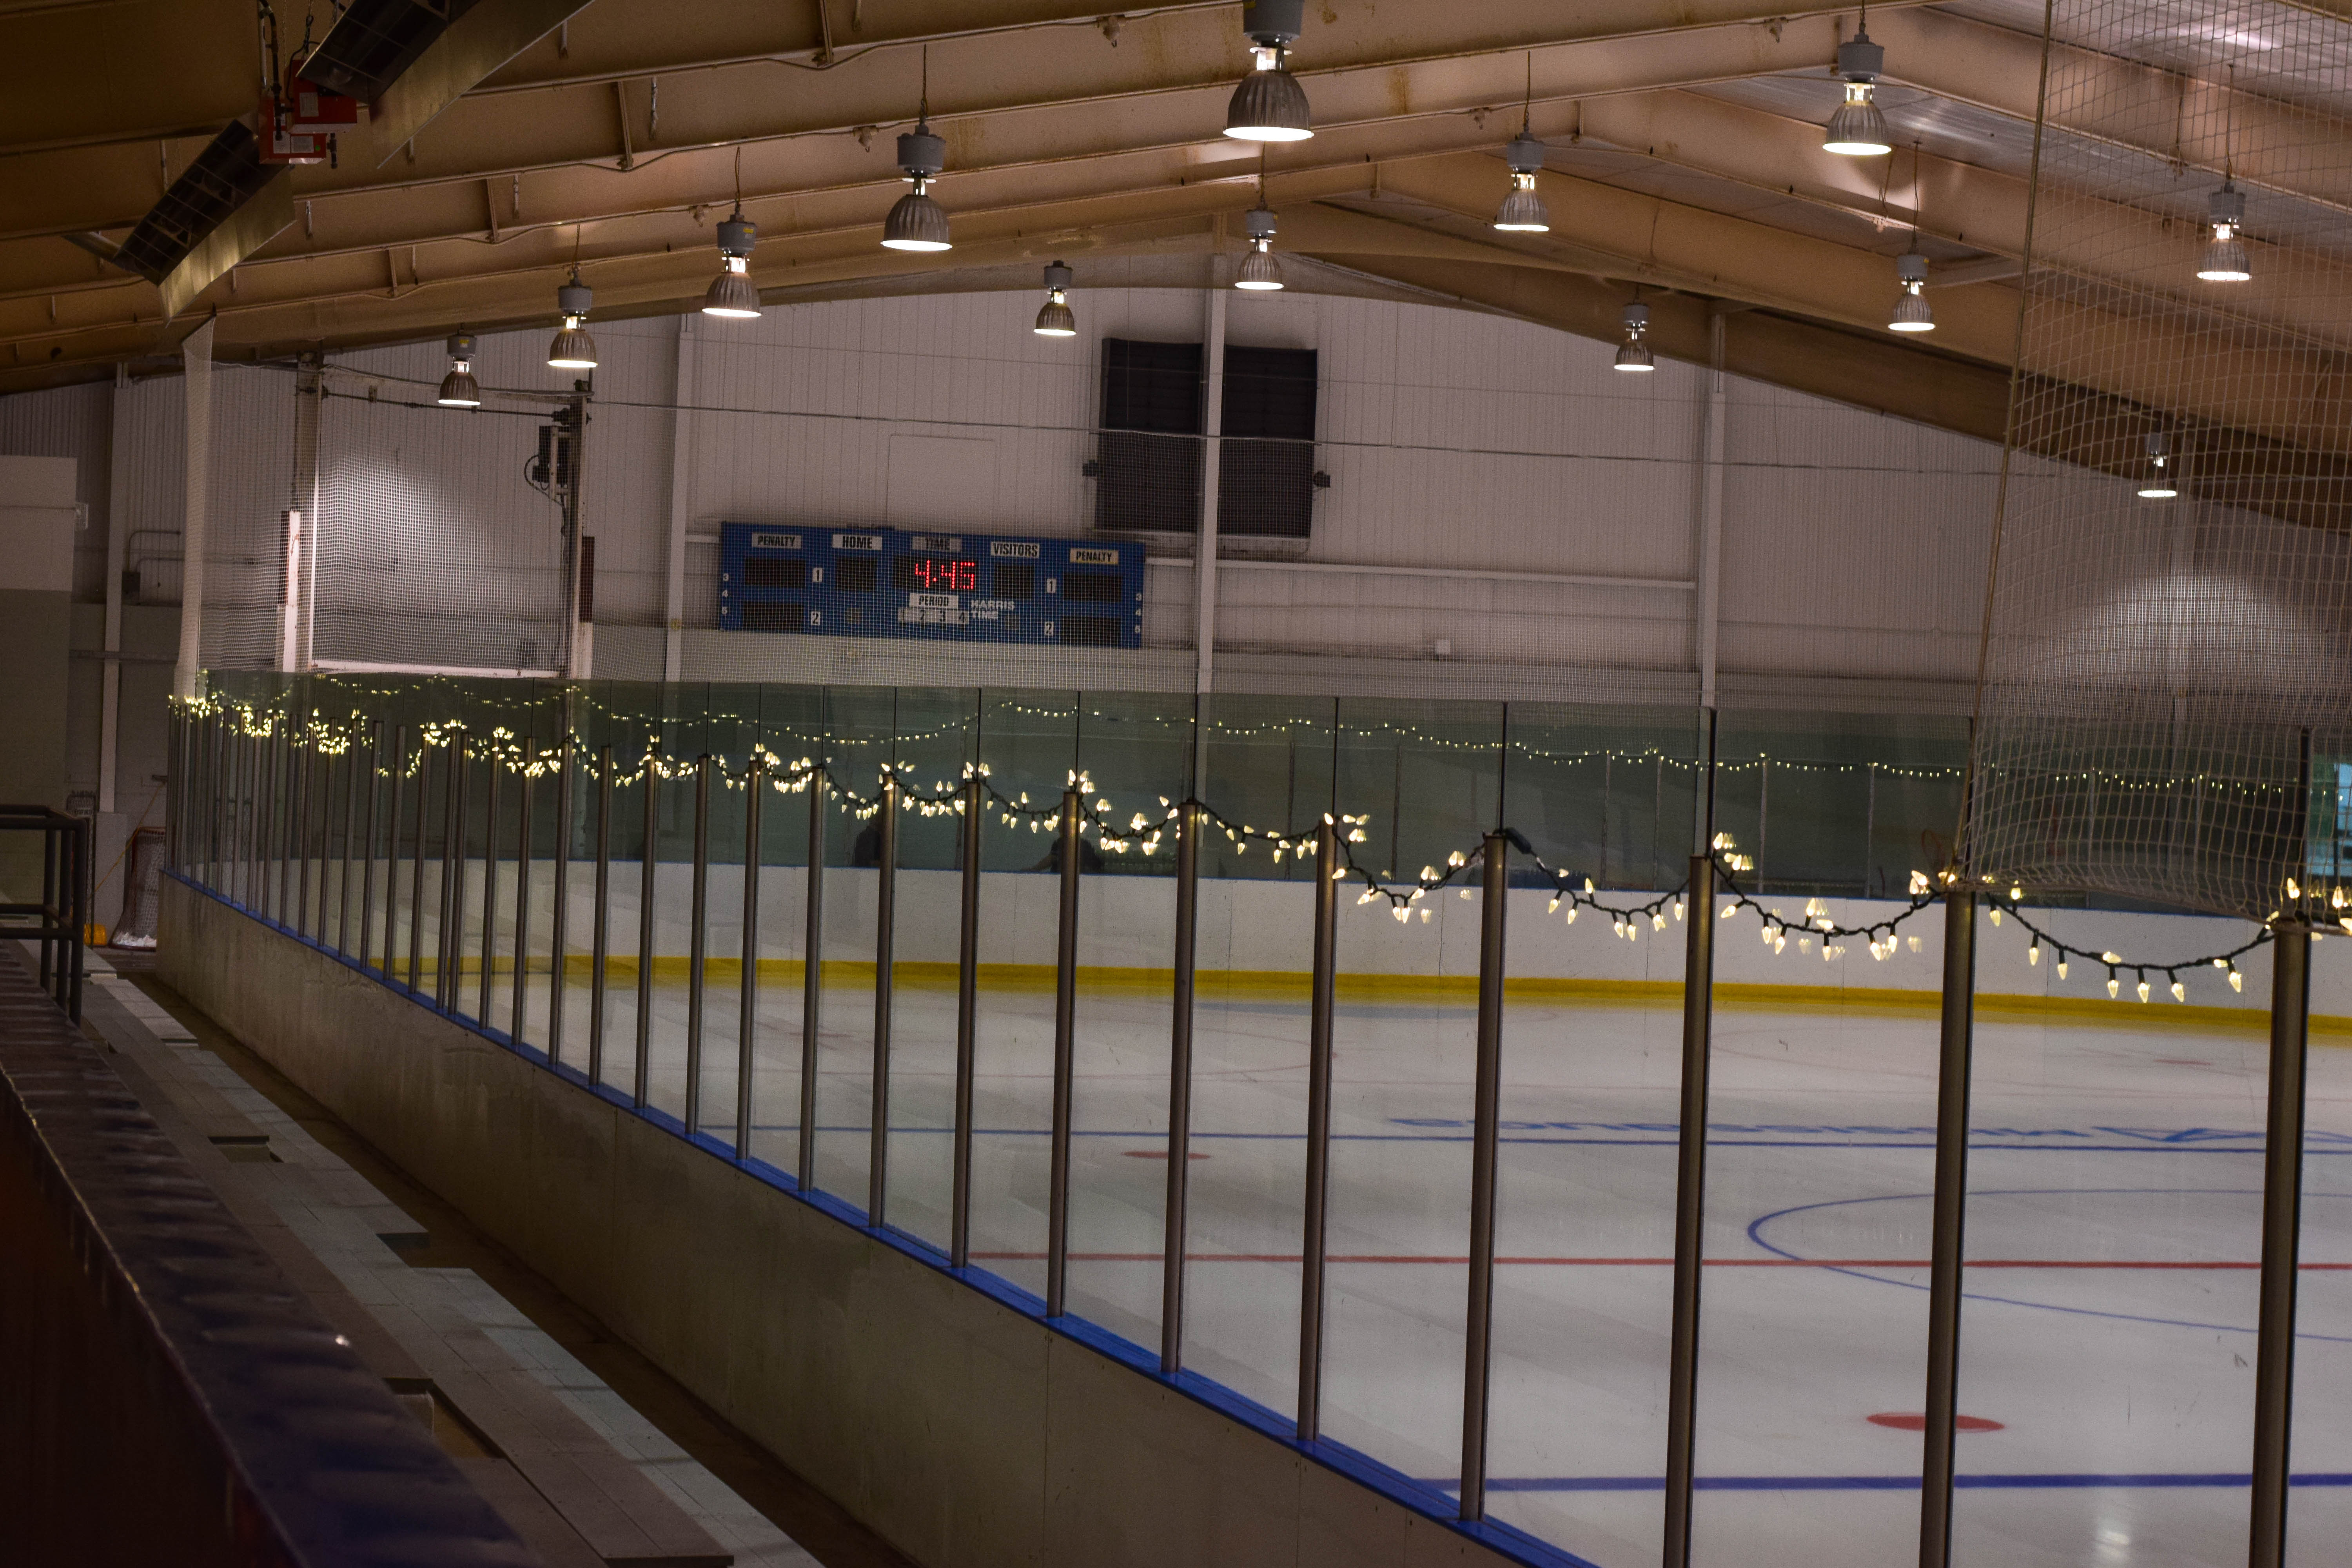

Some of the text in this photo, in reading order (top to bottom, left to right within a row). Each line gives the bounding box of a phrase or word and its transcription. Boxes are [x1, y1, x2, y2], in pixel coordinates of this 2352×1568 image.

[758, 535, 795, 547] PENALTY
[842, 535, 873, 548] HOME
[924, 538, 950, 550] TIME
[993, 543, 1038, 557] VISITORS
[1076, 551, 1112, 562] PENALTY
[722, 573, 729, 582] 3
[816, 569, 820, 582] 1
[1049, 580, 1053, 592] 1
[918, 595, 949, 607] PERIOD
[971, 599, 1015, 610] HARRIS
[812, 613, 819, 624] 2
[1045, 622, 1052, 635] 2
